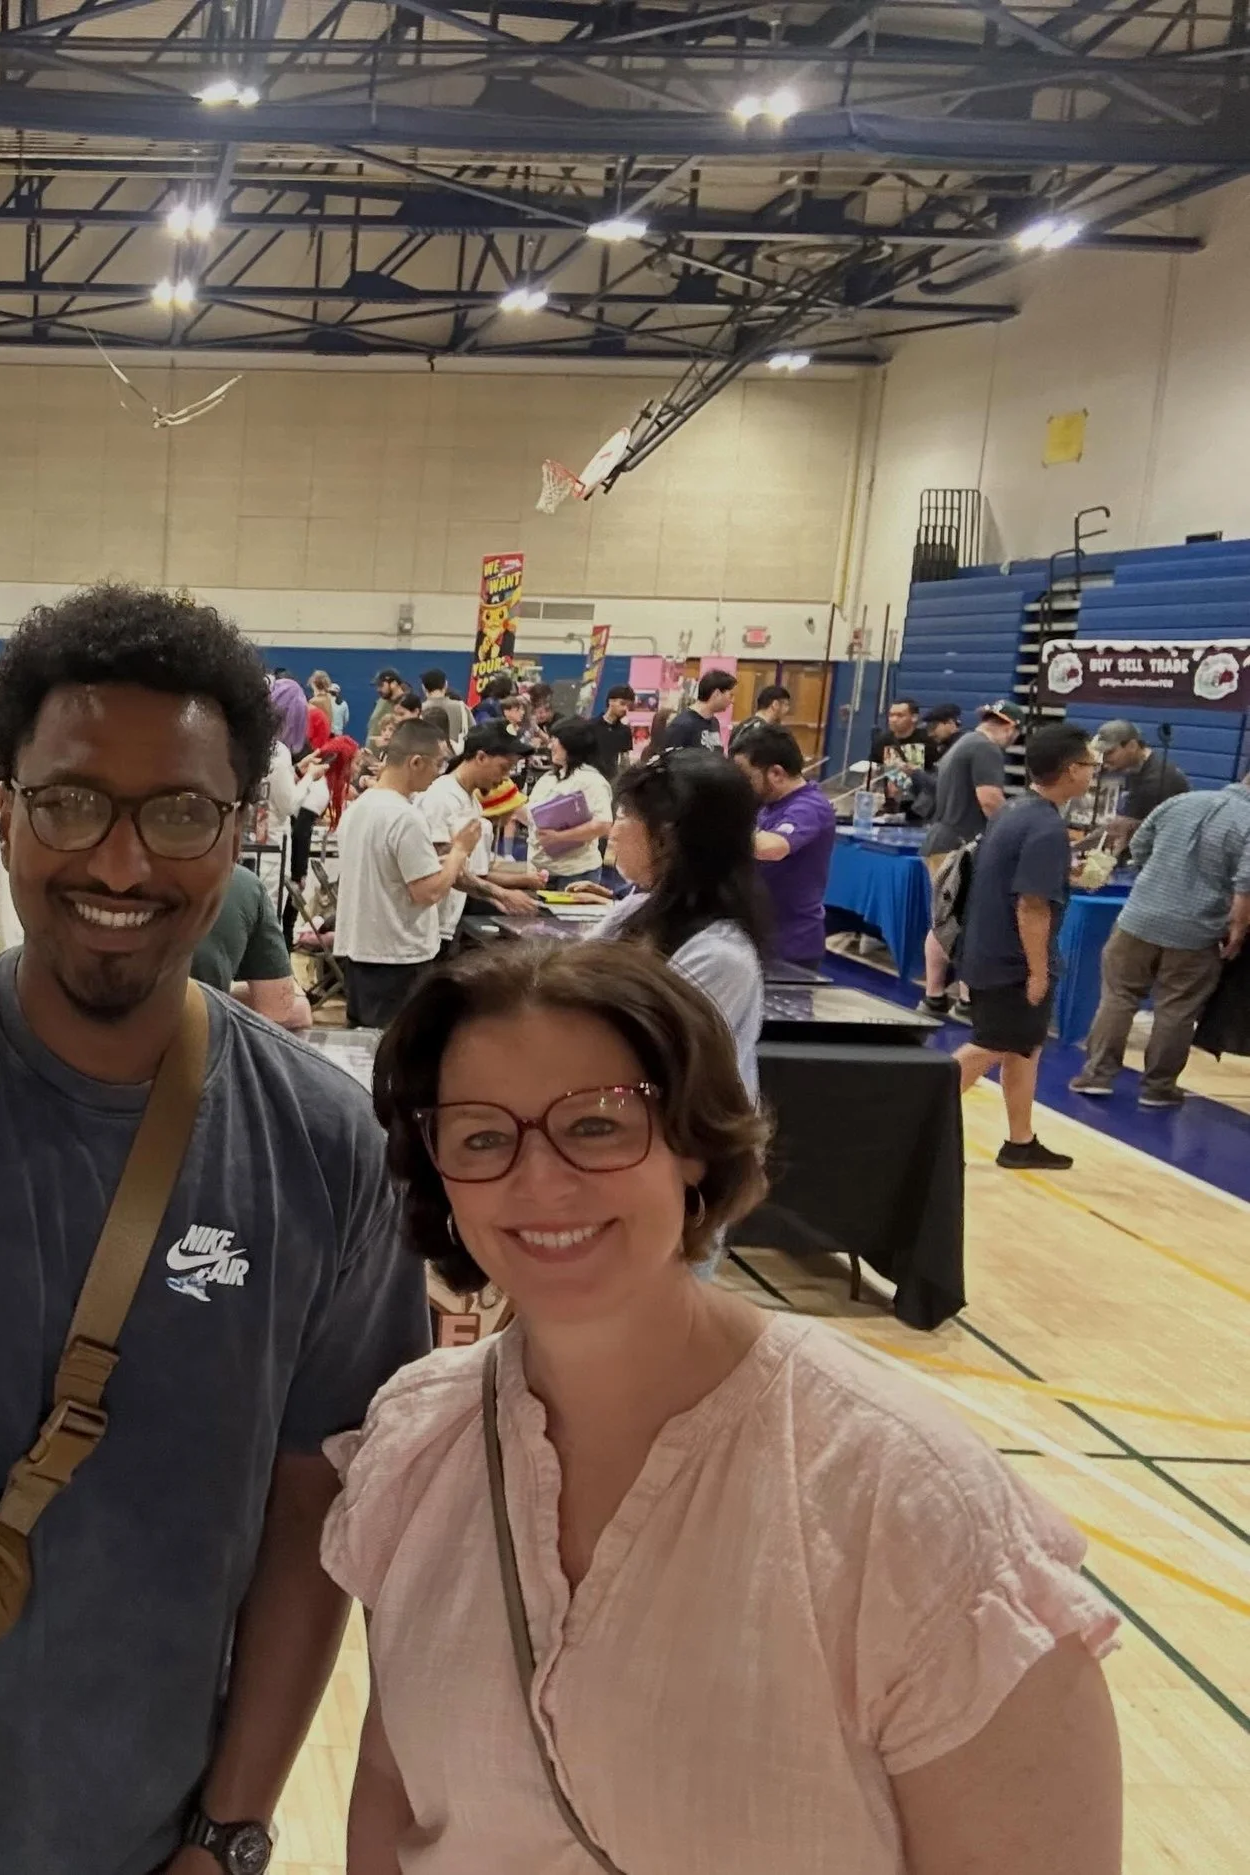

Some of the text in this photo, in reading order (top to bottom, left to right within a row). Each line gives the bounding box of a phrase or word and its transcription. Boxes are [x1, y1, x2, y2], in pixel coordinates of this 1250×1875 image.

[484, 559, 500, 577] WE
[488, 571, 522, 595] WANT
[472, 657, 502, 677] YOUR
[1089, 658, 1190, 673] BUY SELL TRADE
[180, 1224, 235, 1255] NIKE
[205, 1257, 250, 1286] AIR
